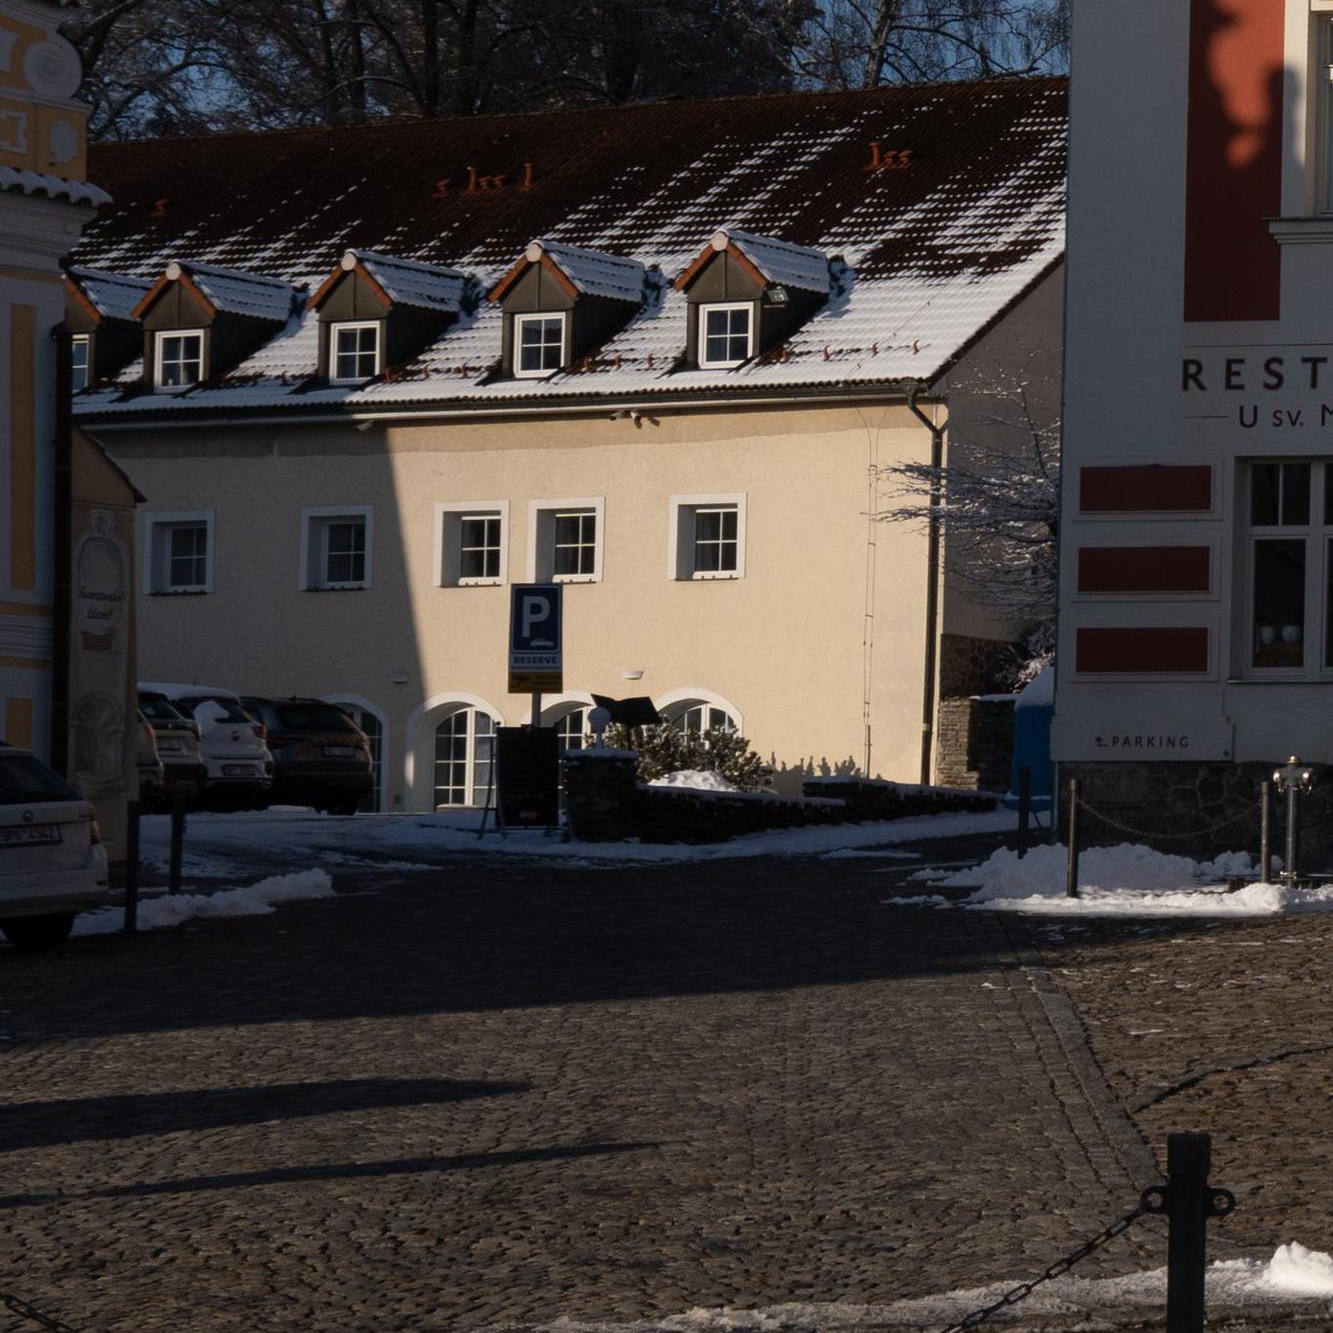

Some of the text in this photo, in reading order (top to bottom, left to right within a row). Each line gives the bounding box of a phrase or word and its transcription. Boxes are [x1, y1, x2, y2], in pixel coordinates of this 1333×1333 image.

[1239, 405, 1259, 429] U
[522, 595, 551, 638] P
[1112, 735, 1190, 749] PARKING
